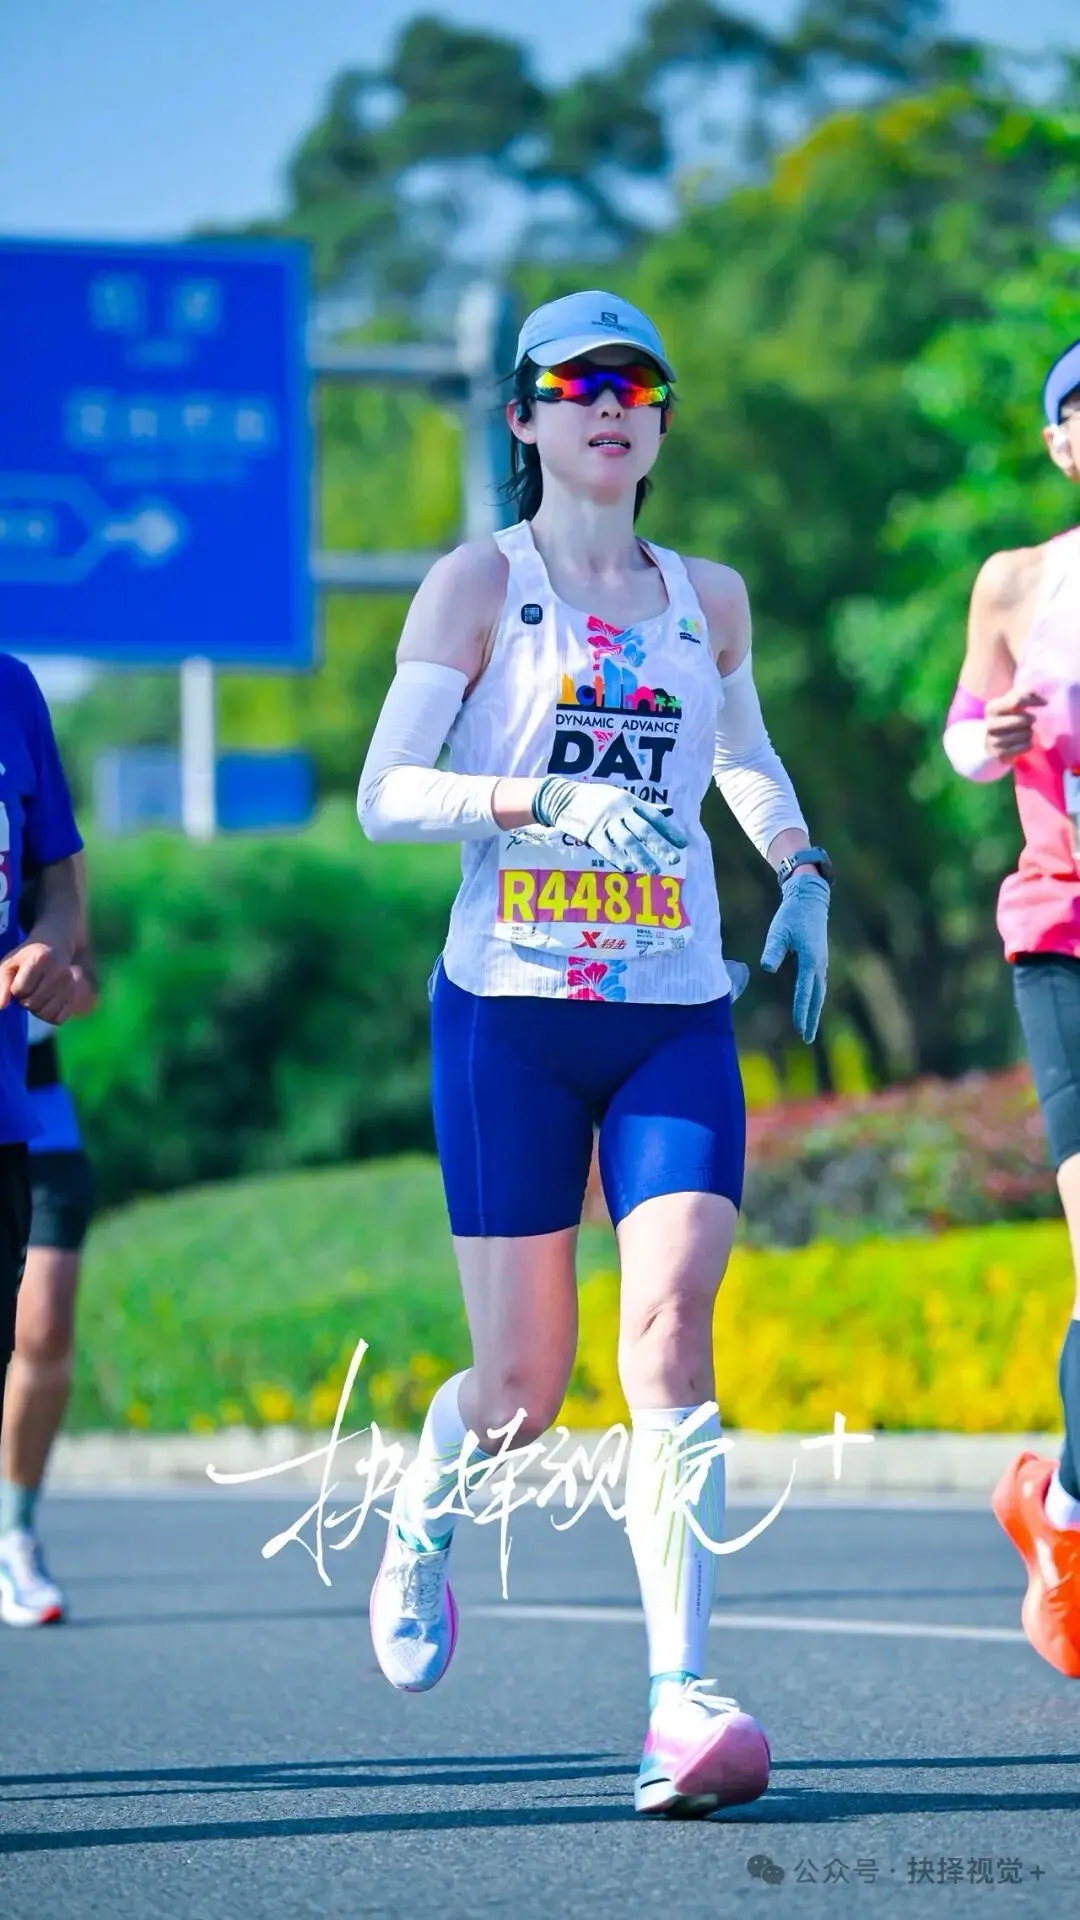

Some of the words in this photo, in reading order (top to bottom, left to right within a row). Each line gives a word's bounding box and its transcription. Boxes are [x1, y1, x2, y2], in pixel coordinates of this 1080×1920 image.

[555, 713, 615, 729] DYNAMIC
[621, 719, 680, 735] ADVANCE
[547, 729, 676, 784] DAT
[503, 871, 682, 930] R44813
